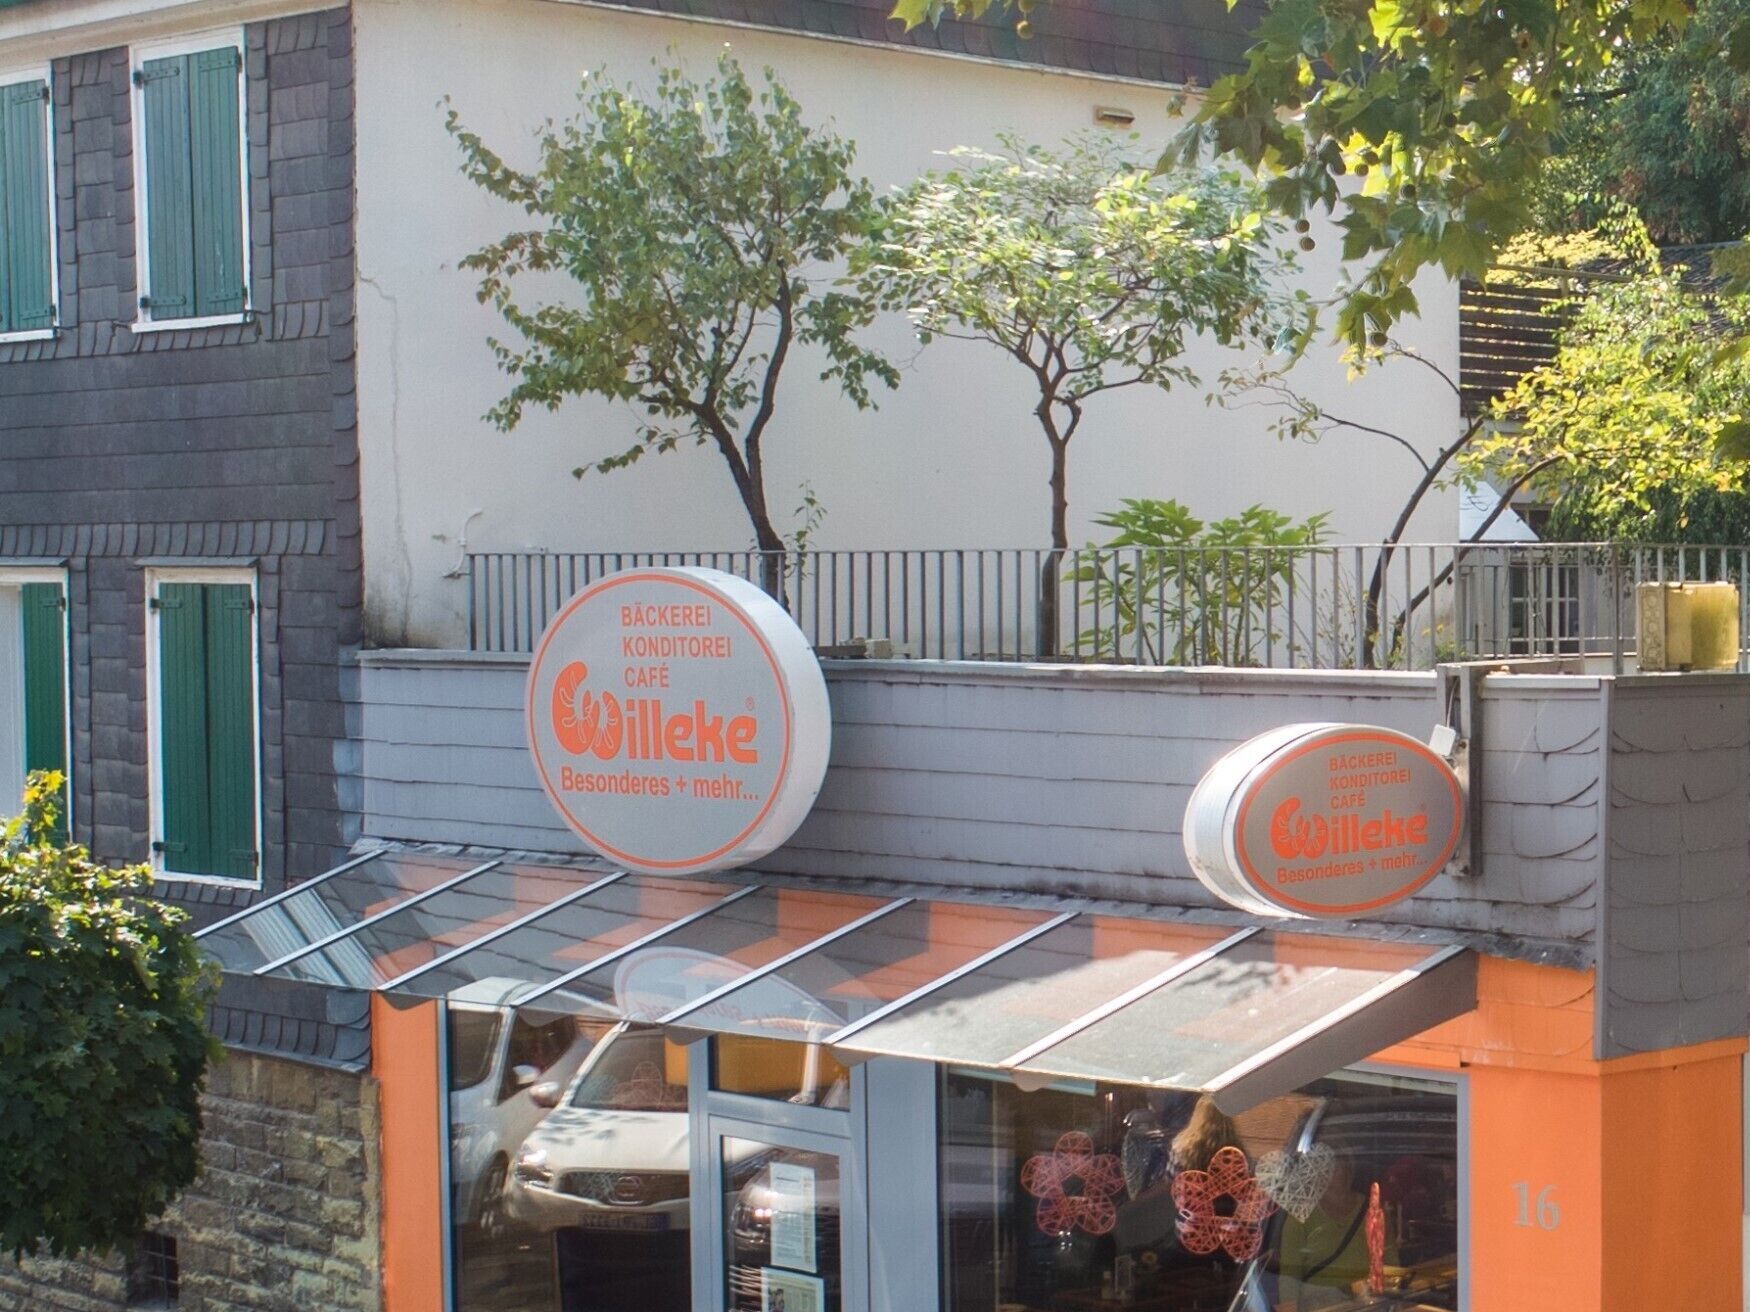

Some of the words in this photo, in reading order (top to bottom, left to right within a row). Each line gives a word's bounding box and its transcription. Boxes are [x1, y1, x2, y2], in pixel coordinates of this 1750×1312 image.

[621, 601, 711, 627] BÄCKEREI
[623, 636, 733, 658] KONDITOREI
[624, 662, 670, 688] CAFÉ
[552, 661, 758, 764] Willeke
[1328, 752, 1397, 772] BÄCKEREI
[561, 766, 670, 797] Besonderes
[693, 774, 759, 800] mehr...
[1329, 768, 1411, 790] KONDITOREI
[1330, 789, 1366, 809] CAFÉ
[1270, 797, 1428, 859] Willeke
[1276, 859, 1364, 885] Besonderes
[1381, 852, 1428, 869] mehr...
[1510, 1181, 1562, 1232] 16
